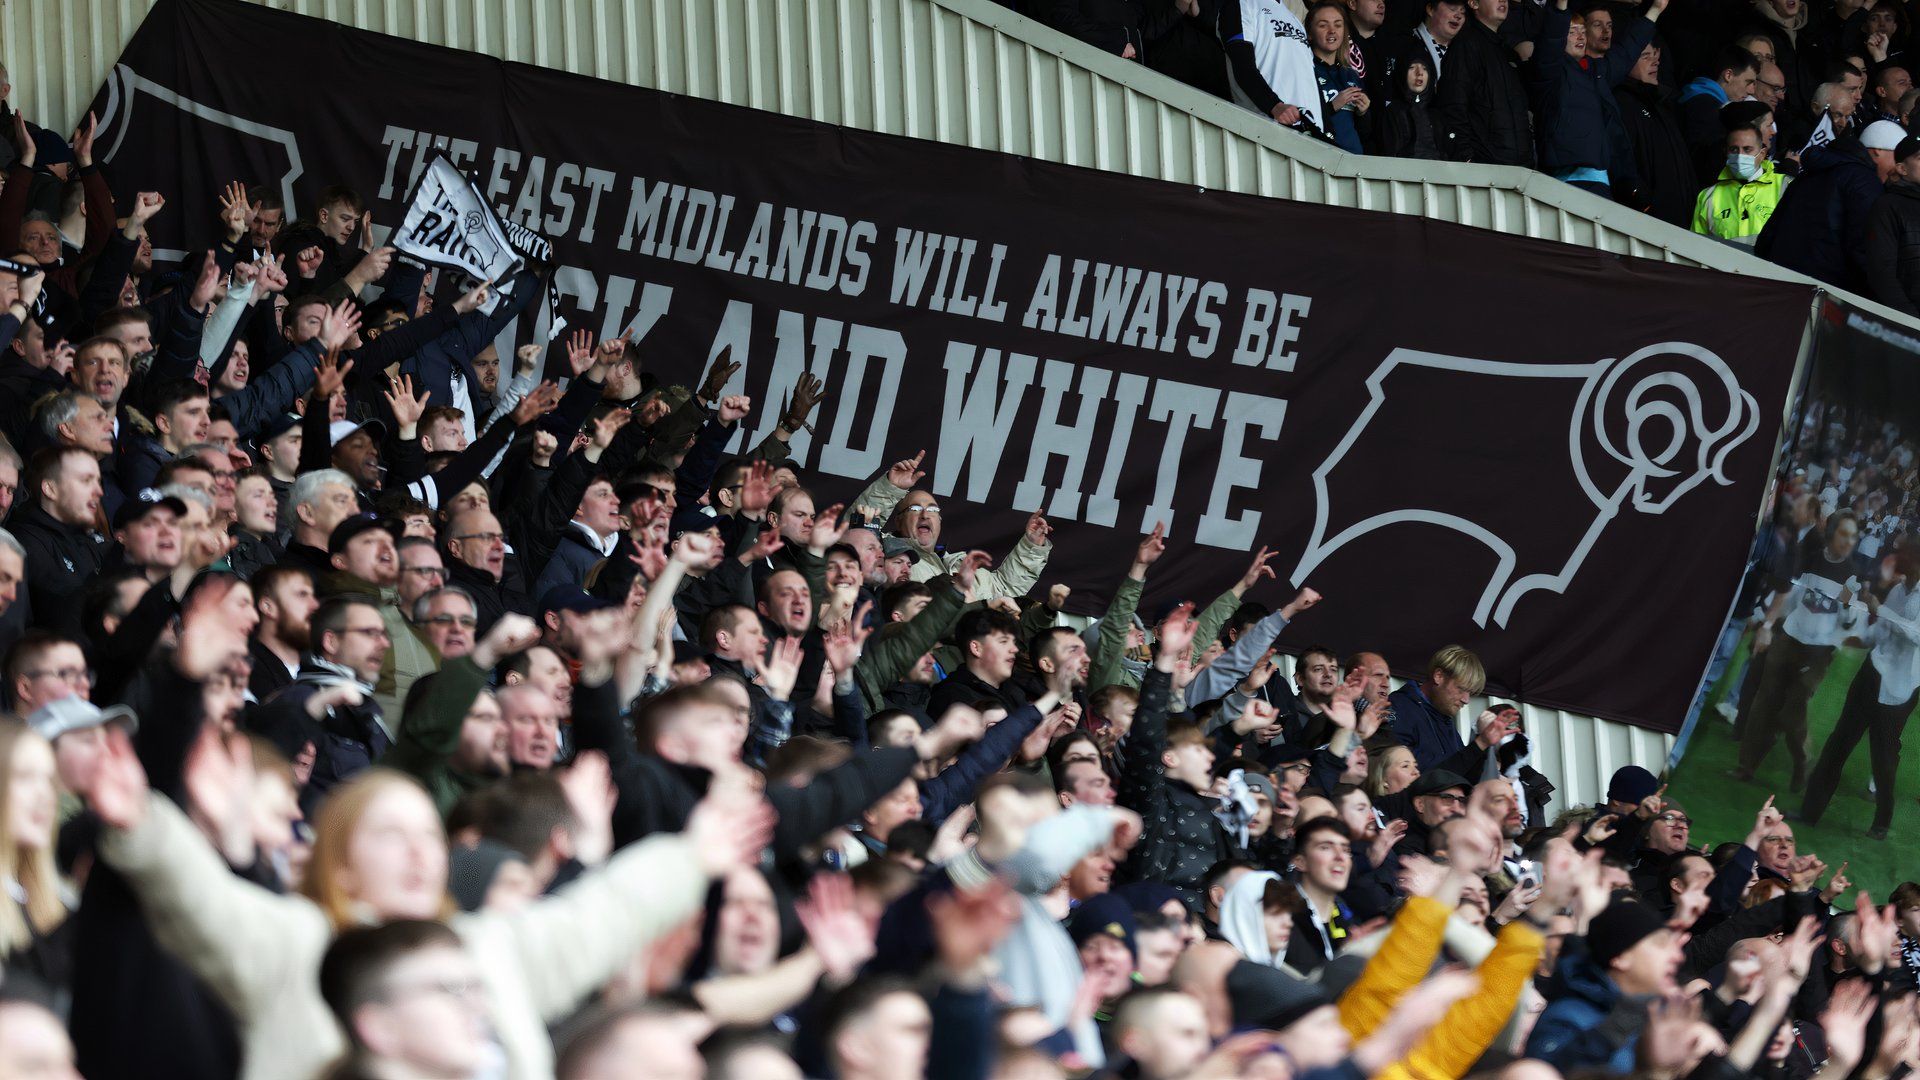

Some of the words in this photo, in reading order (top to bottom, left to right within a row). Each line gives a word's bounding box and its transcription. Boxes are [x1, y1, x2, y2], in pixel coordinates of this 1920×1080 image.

[487, 147, 616, 243] EAST
[617, 176, 878, 297] MIDLANDS
[890, 226, 1008, 323] WILL
[1022, 254, 1228, 359] ALWAYS
[1232, 287, 1312, 372] BE
[696, 299, 908, 481] AND
[932, 340, 1288, 552] WHITE
